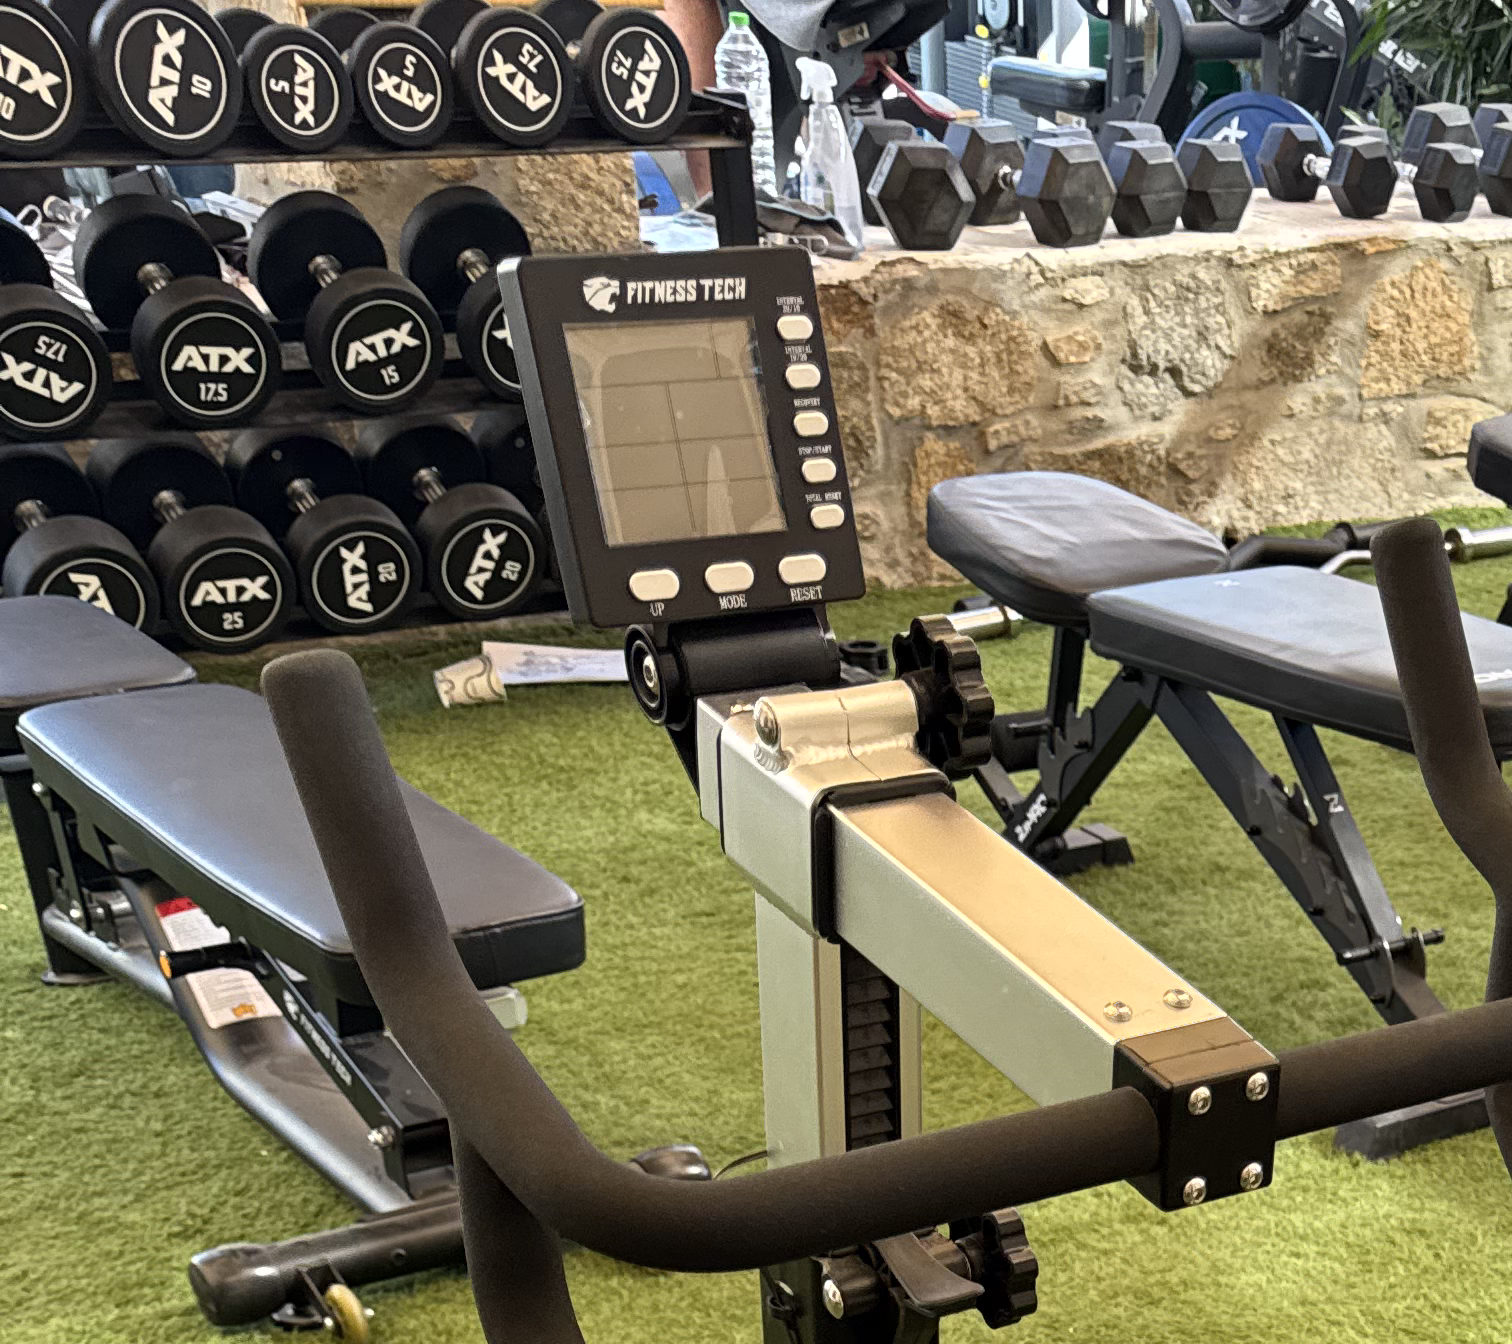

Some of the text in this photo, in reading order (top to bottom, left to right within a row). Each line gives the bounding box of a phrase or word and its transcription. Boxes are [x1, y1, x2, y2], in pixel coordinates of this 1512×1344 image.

[403, 54, 417, 77] 5
[519, 42, 544, 74] 7.5
[611, 49, 632, 80] 7.5
[0, 43, 62, 109] TX
[148, 18, 187, 128] ATX
[191, 73, 212, 99] 10
[270, 78, 290, 94] 5
[485, 48, 552, 112] ATX
[624, 38, 662, 120] ATX
[294, 52, 316, 128] ATX
[374, 67, 434, 112] ATX
[626, 277, 746, 305] FITNESS TECH
[34, 334, 69, 363] 17.5
[171, 345, 256, 374] ATX
[344, 320, 421, 371] ATX
[0, 351, 85, 404] ATX
[380, 366, 400, 386] 15
[199, 383, 228, 401] 17.5
[339, 540, 374, 613] ATX
[378, 562, 397, 582] 20
[462, 527, 508, 600] ATX
[502, 560, 522, 581] 20
[191, 574, 272, 608] ATX
[719, 594, 747, 610] MODE
[789, 586, 822, 602] RESET
[222, 611, 244, 629] 25
[650, 603, 665, 617] UP
